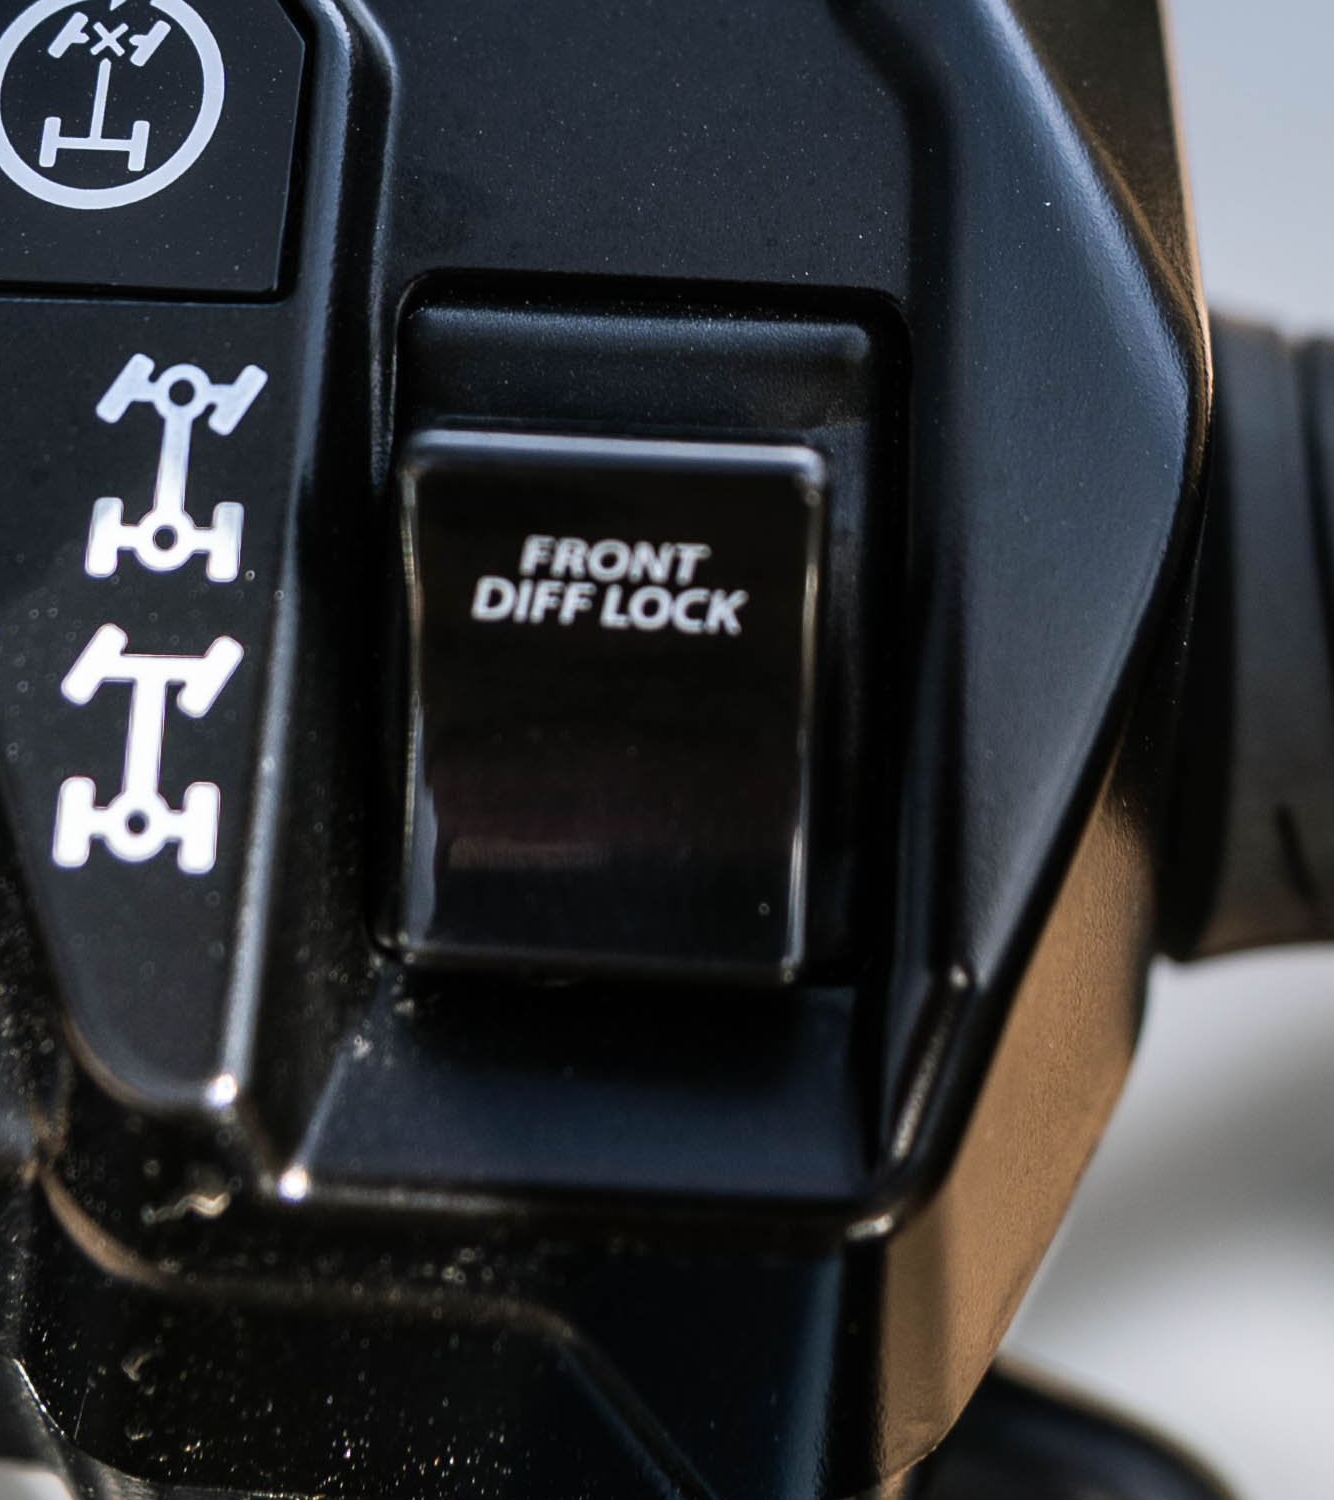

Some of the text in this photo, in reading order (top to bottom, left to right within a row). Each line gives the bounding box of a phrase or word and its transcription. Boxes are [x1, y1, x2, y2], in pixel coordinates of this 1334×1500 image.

[518, 533, 712, 587] FRONT
[470, 575, 749, 638] DIFF LOCK
